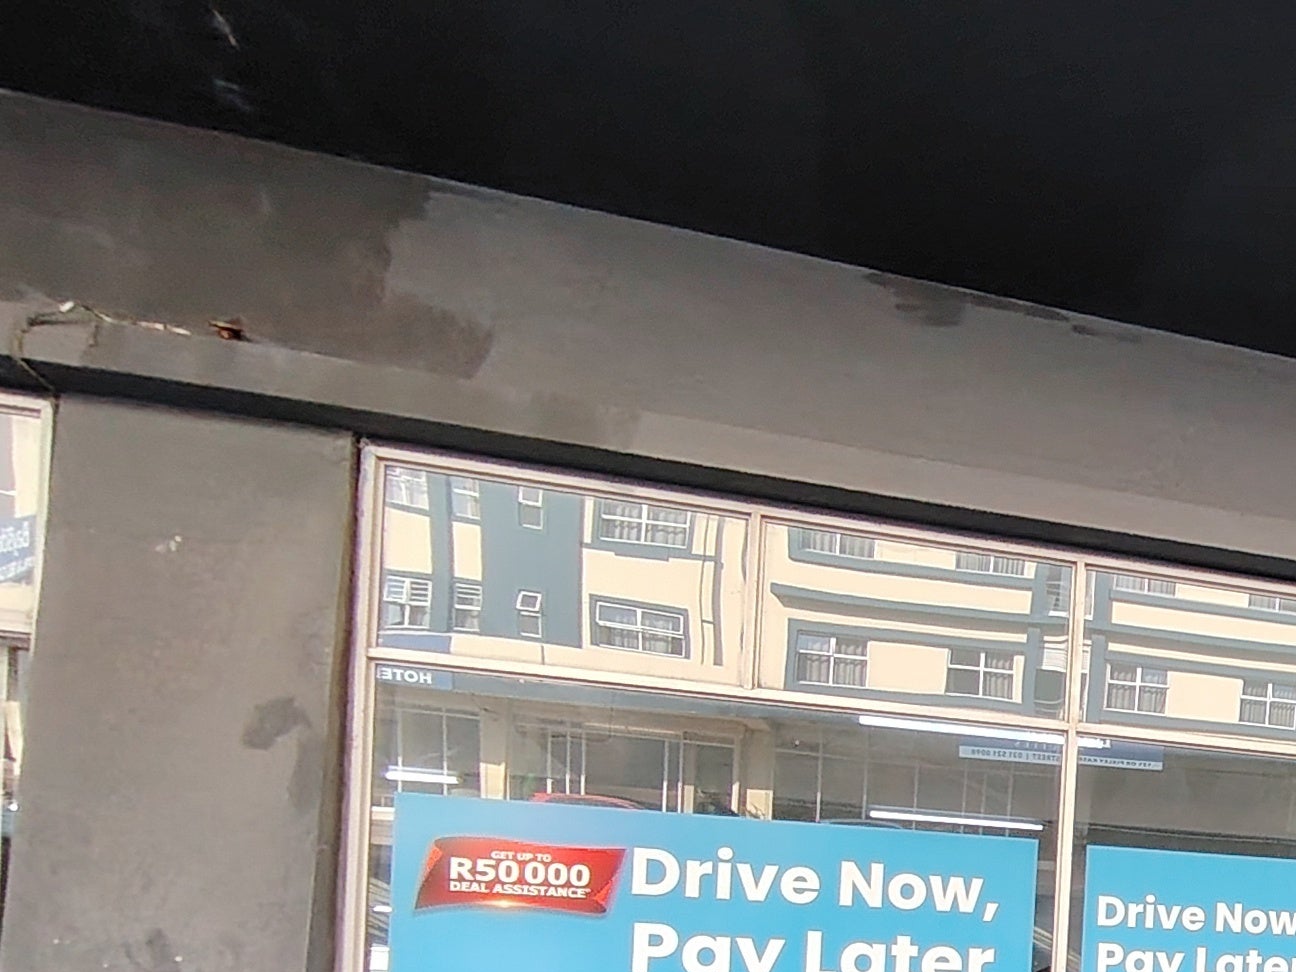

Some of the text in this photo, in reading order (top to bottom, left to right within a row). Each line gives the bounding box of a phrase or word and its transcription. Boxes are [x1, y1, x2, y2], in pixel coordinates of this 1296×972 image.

[491, 851, 551, 862] GET UP TO
[450, 857, 591, 887] R50 000
[631, 846, 999, 922] Drive Now,
[450, 881, 491, 894] DEAL
[1097, 894, 1206, 931] Drive
